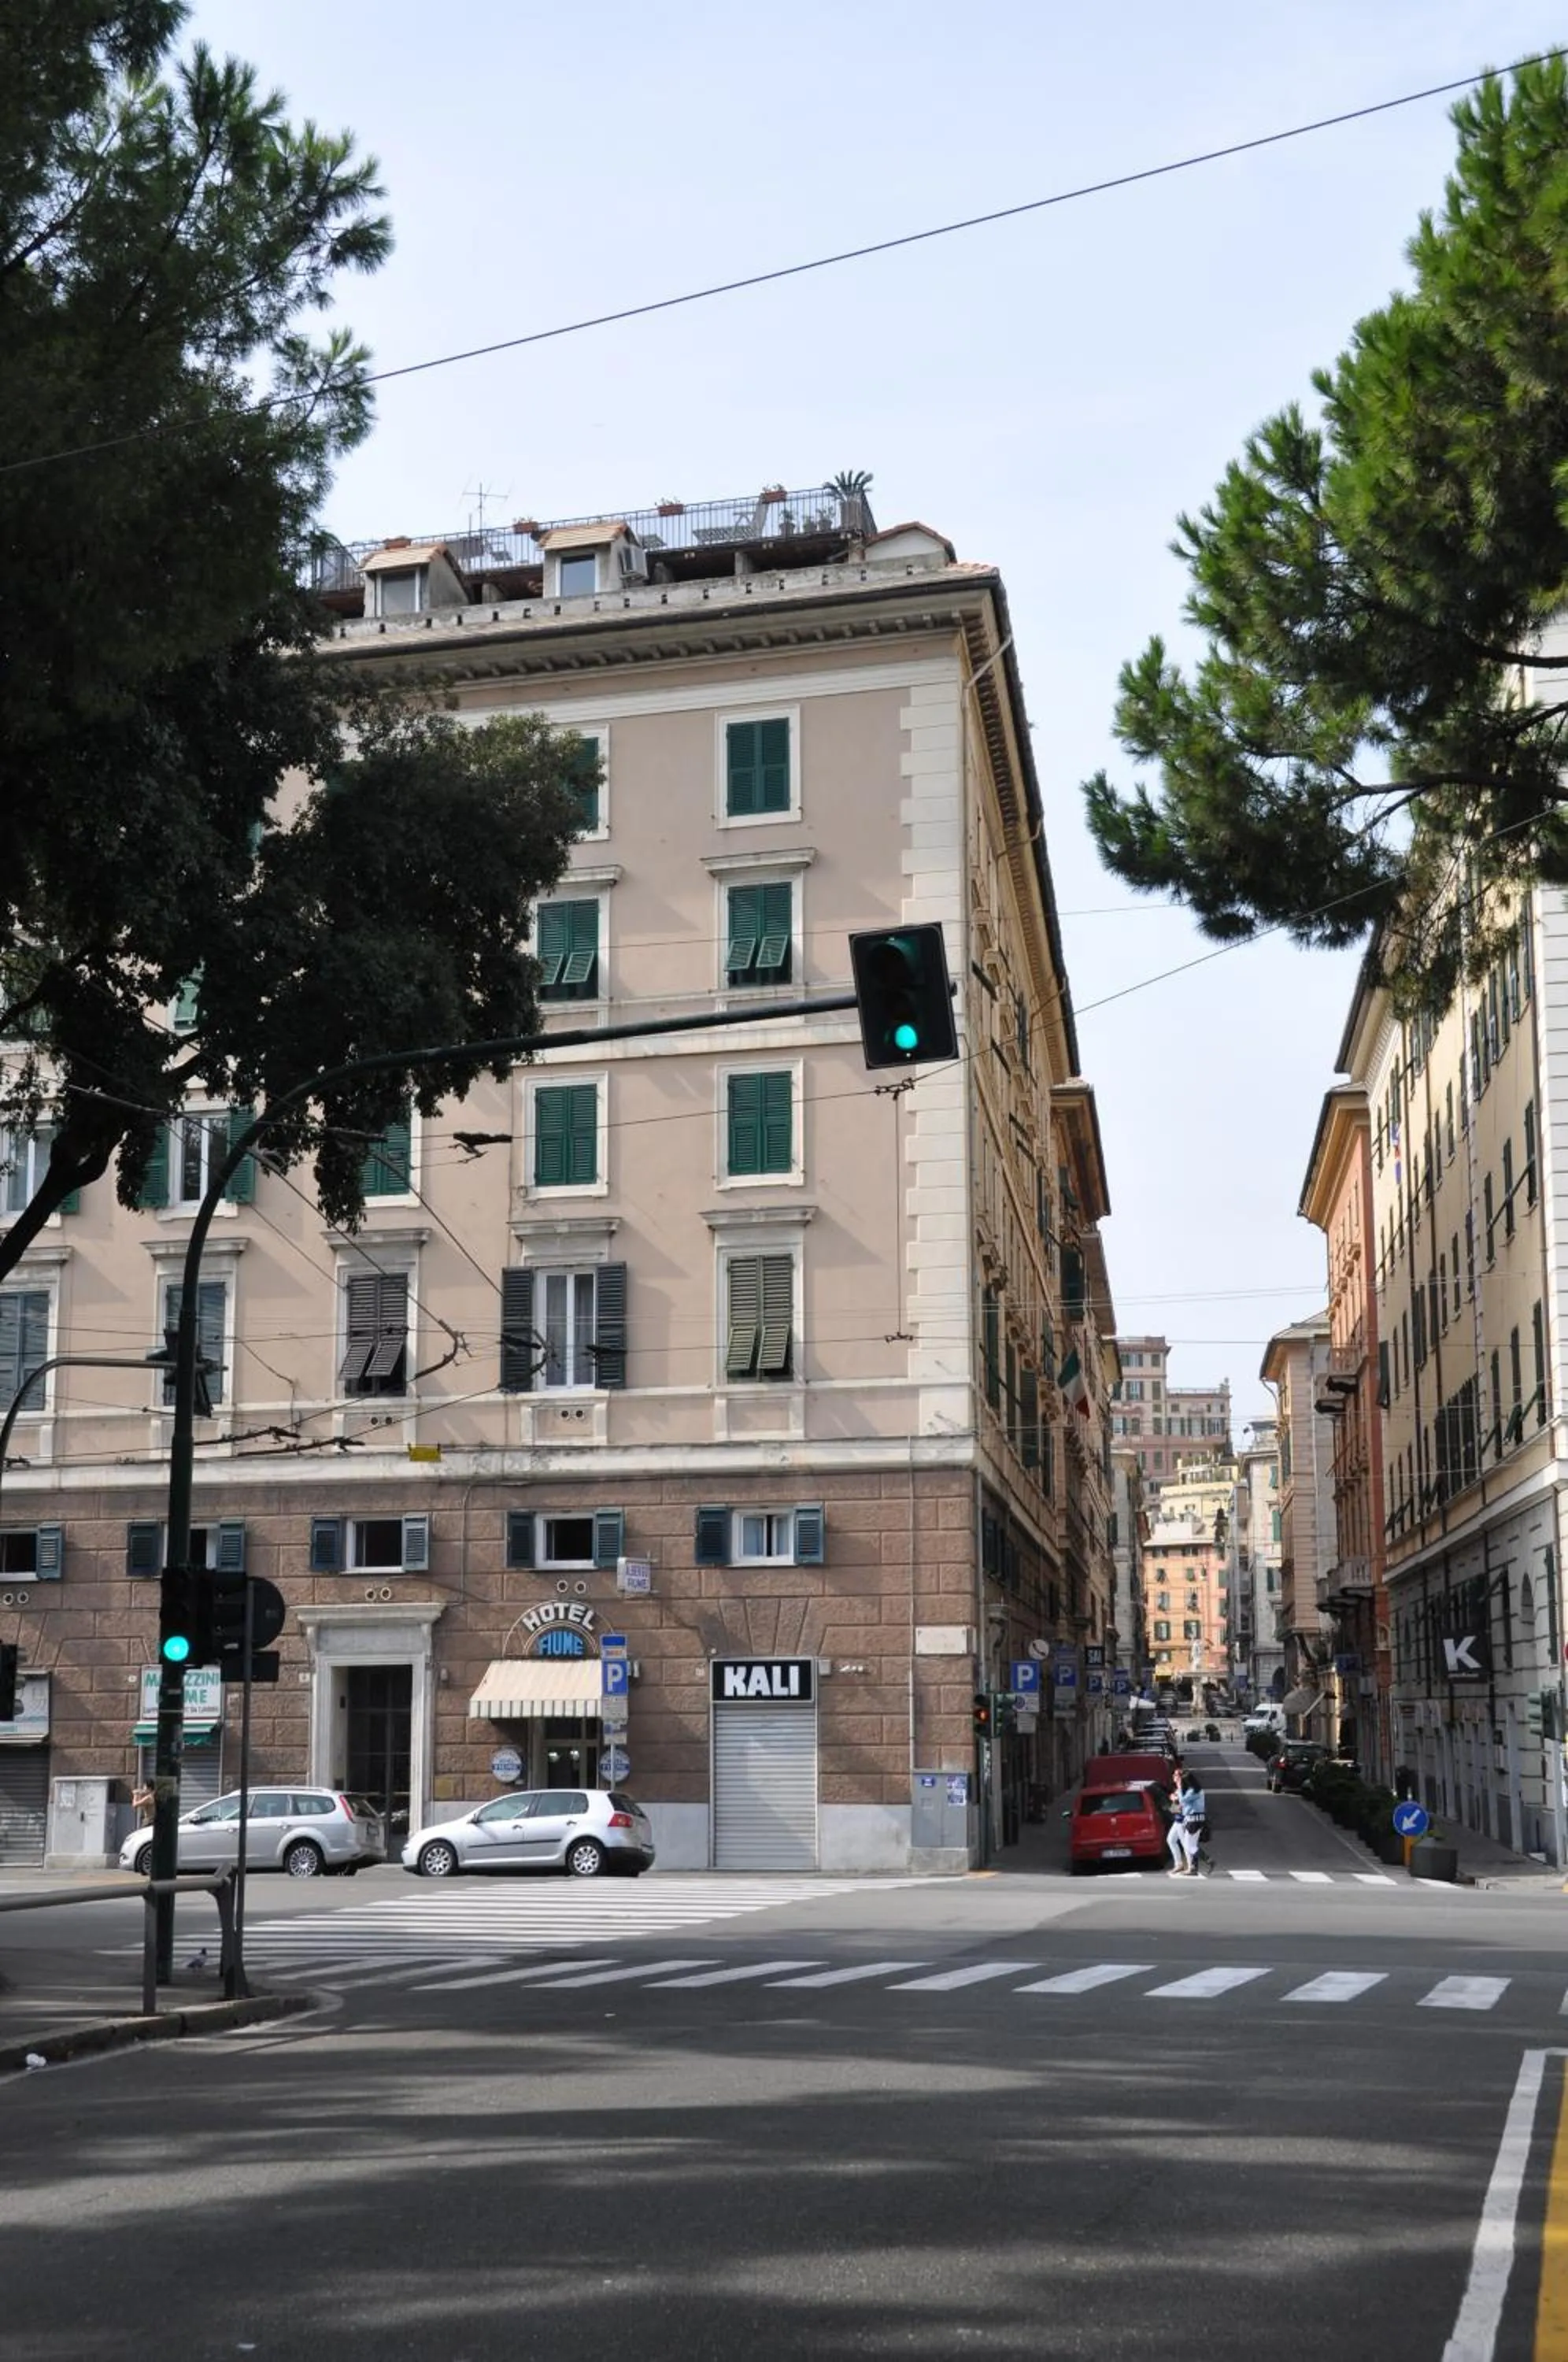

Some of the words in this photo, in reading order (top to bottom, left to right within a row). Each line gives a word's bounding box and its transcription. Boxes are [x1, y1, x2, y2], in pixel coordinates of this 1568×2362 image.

[523, 1602, 594, 1632] HOTEL
[538, 1631, 584, 1656] FIUME
[1443, 1635, 1482, 1672] K
[145, 1672, 220, 1686] MZZINI
[607, 1663, 623, 1692] P
[723, 1665, 800, 1697] KALI
[1016, 1664, 1034, 1690] P
[1058, 1666, 1072, 1686] P
